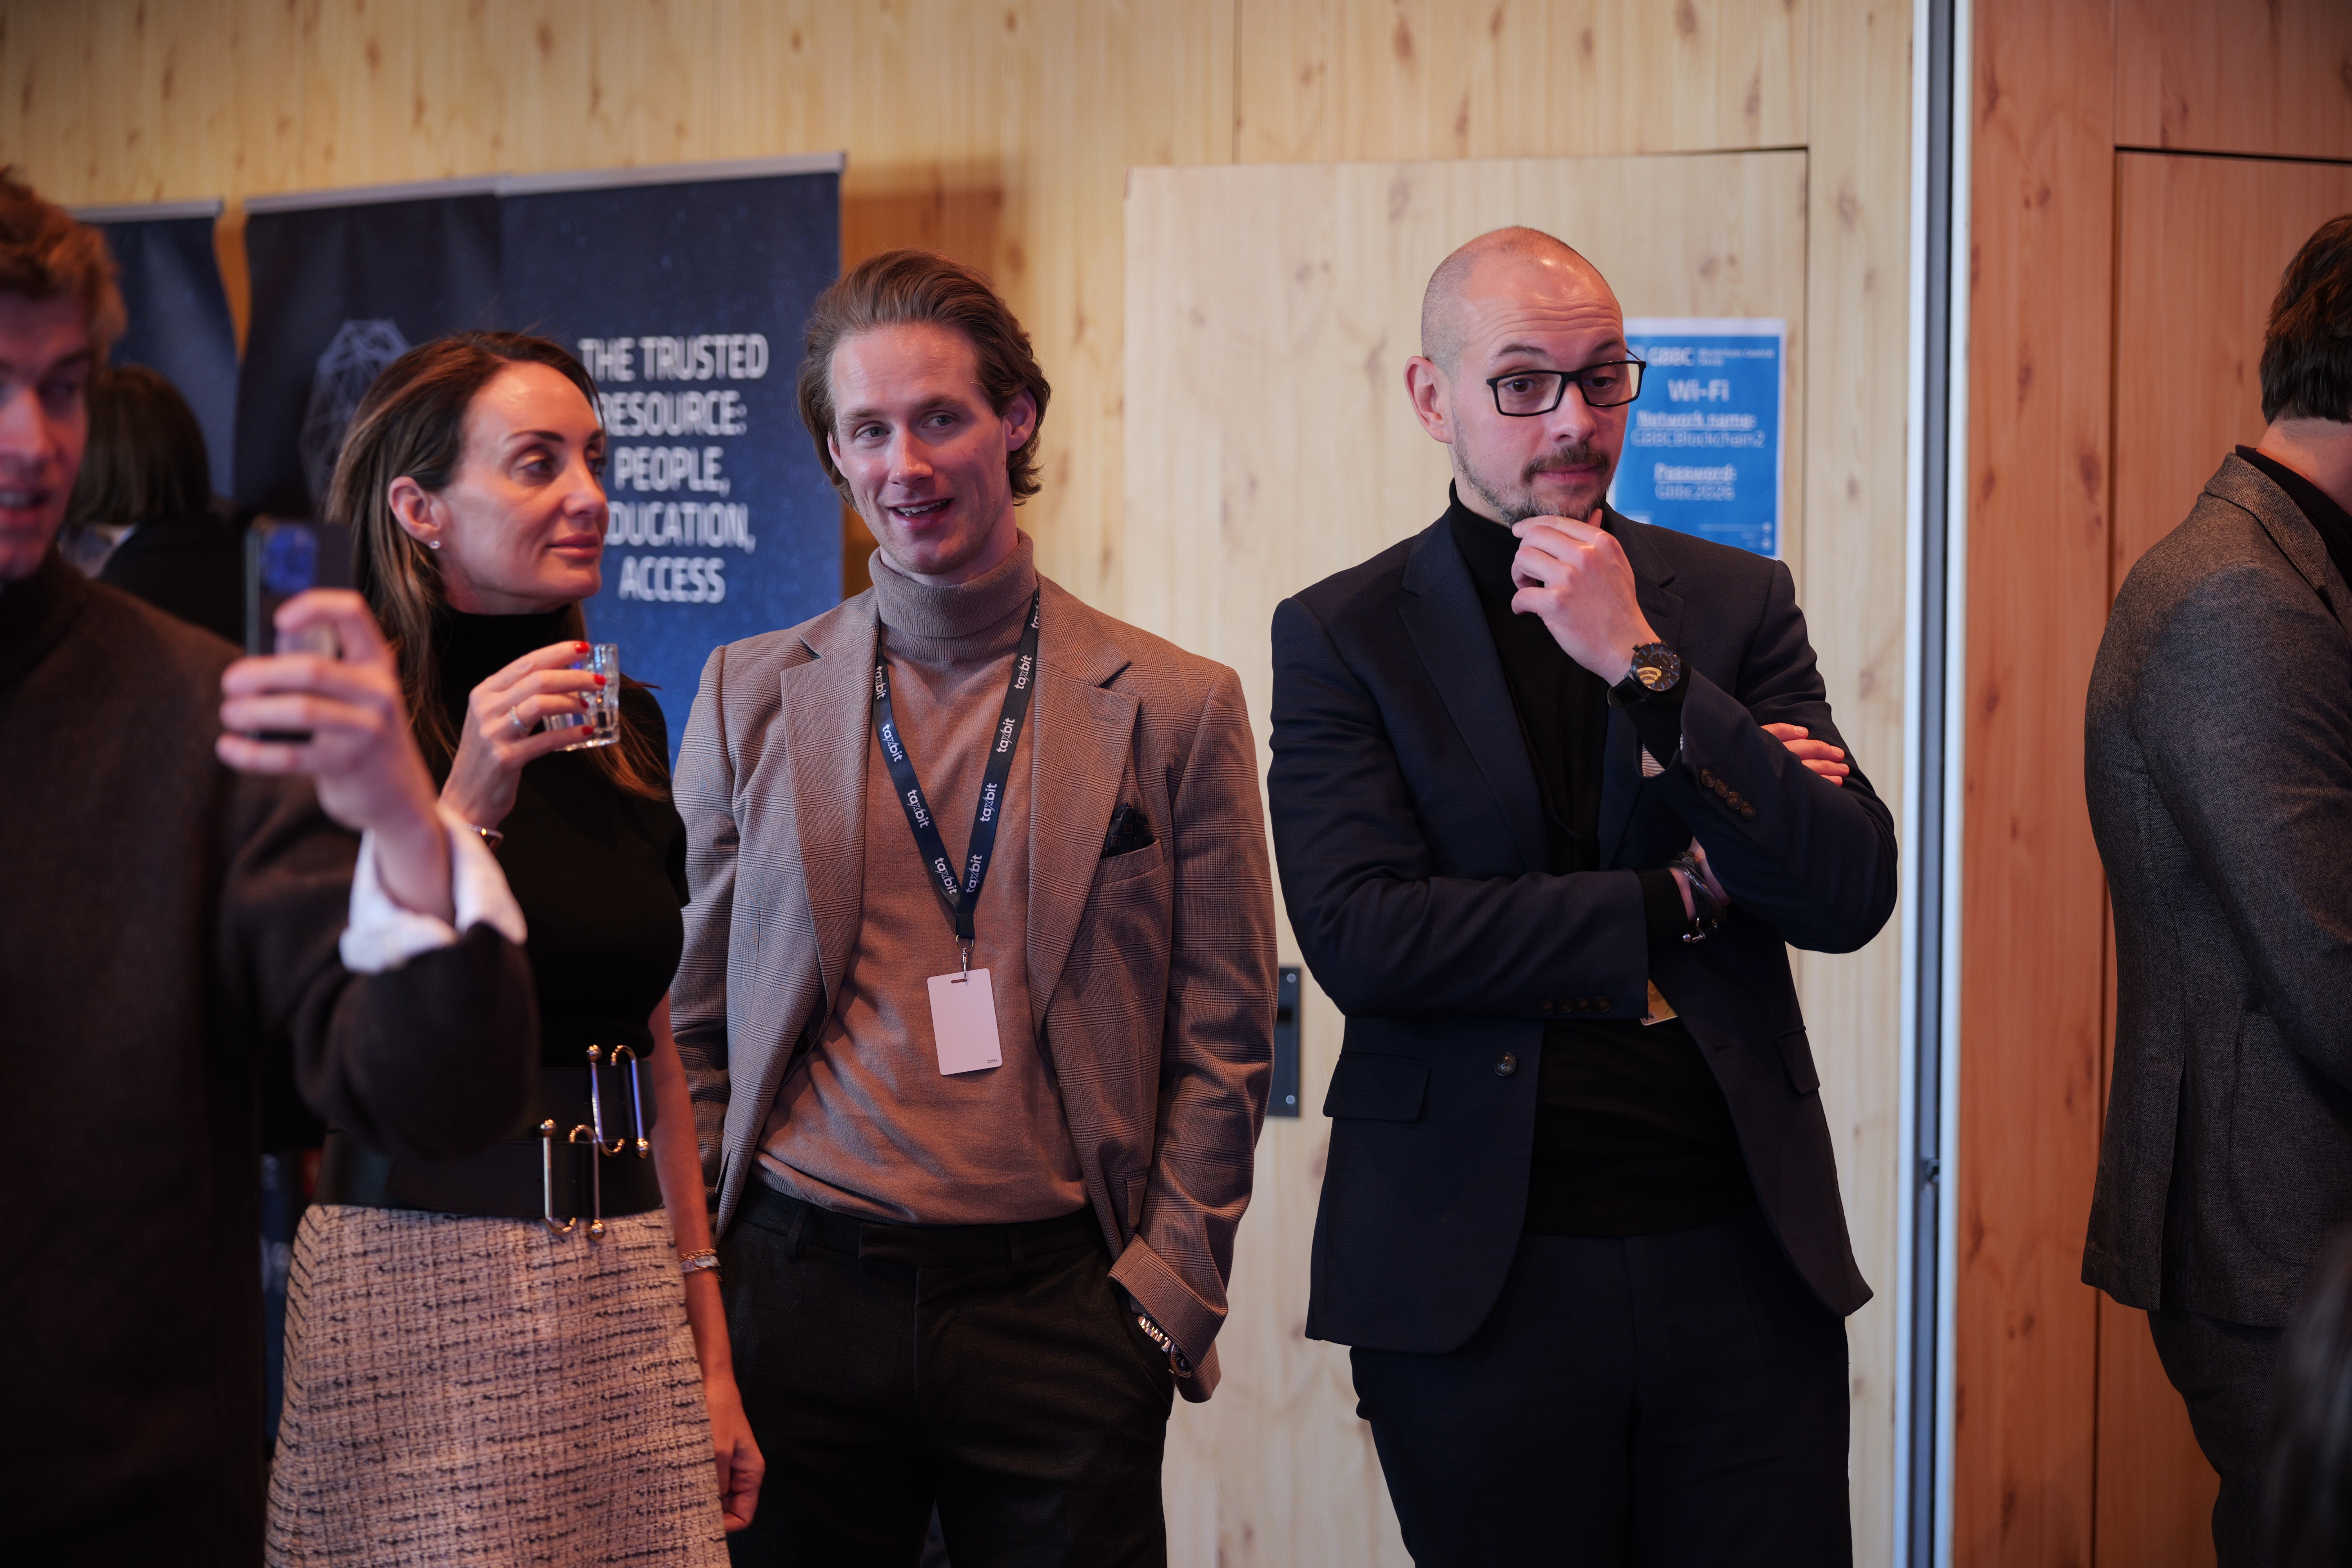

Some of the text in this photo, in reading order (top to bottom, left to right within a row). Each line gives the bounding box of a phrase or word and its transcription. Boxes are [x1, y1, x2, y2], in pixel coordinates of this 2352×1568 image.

[577, 334, 769, 382] THE TRUSTED
[1636, 409, 1705, 428] Network
[614, 445, 731, 497] PEOPLE,
[604, 501, 756, 554] DUCATION,
[619, 555, 726, 604] ACCESS
[1014, 655, 1033, 690] taxbit
[882, 724, 903, 762] taxbit
[996, 718, 1015, 753] taxbit
[907, 789, 929, 828] taxbit
[980, 783, 997, 822] taxbit
[934, 857, 958, 894] taxbit
[965, 854, 983, 893] taxbit
